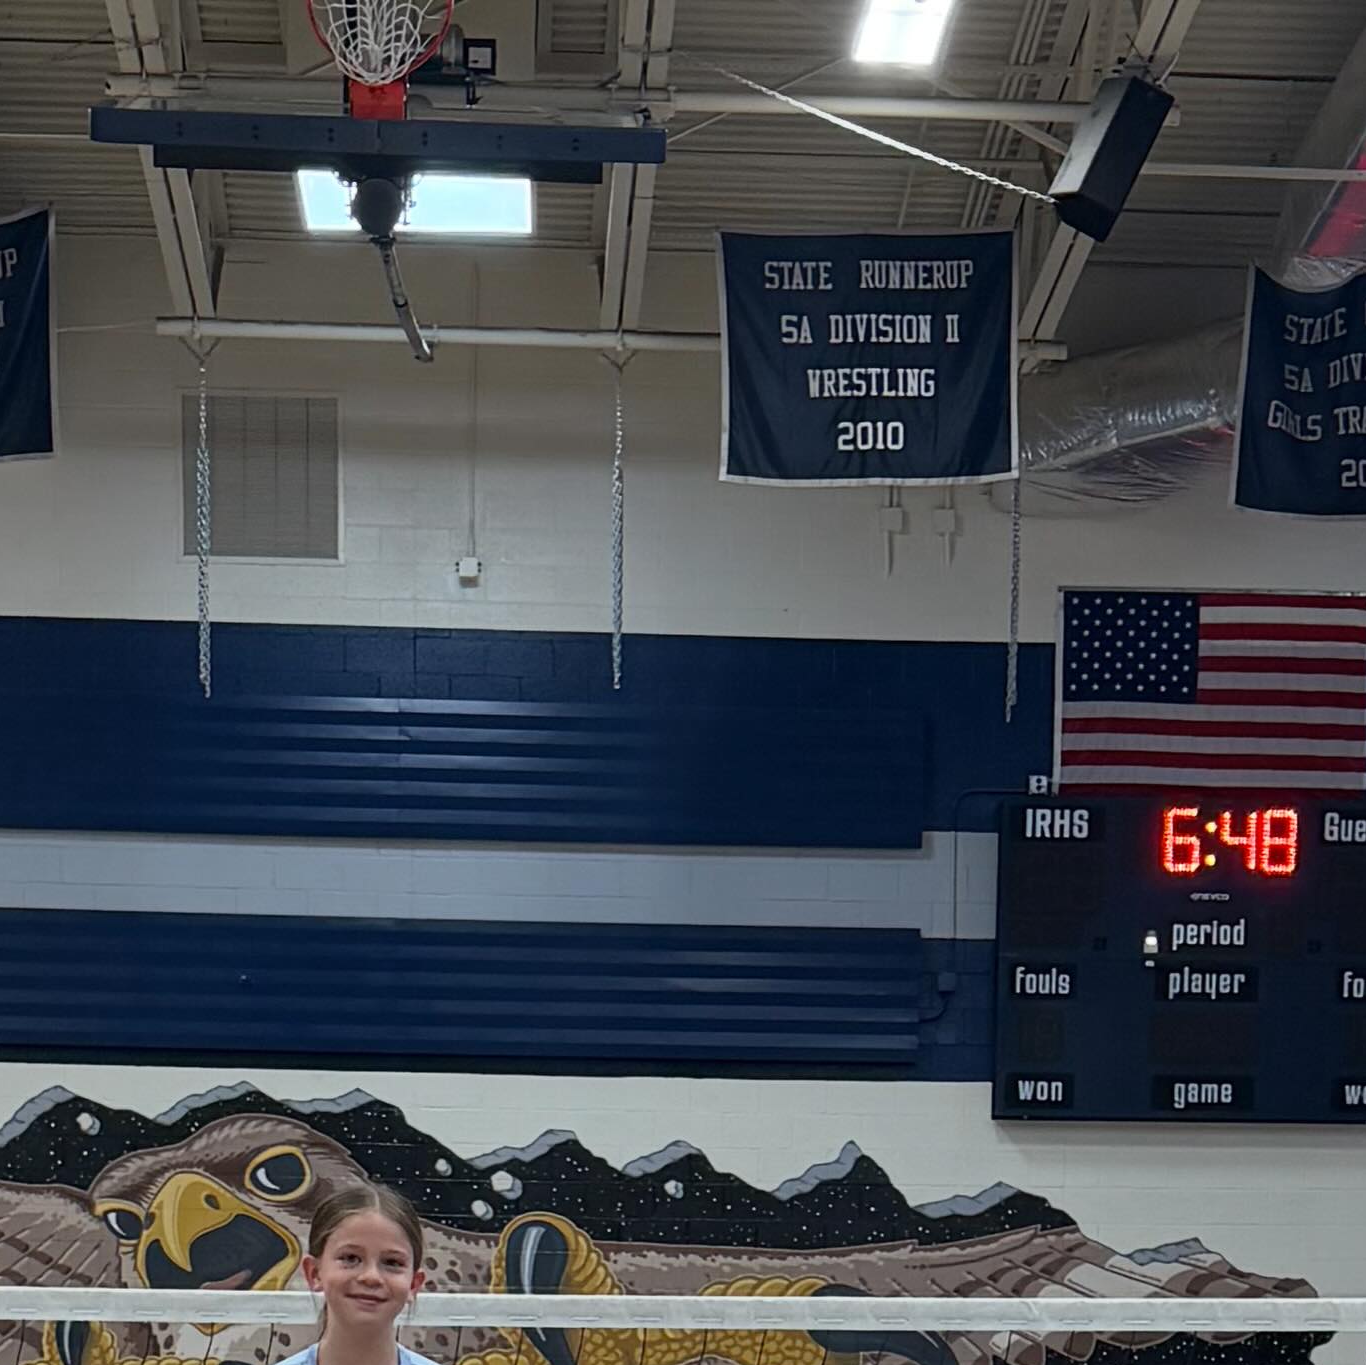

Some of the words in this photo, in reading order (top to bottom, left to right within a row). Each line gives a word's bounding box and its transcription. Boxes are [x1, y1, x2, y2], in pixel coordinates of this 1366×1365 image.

[764, 261, 833, 290] STATE
[859, 260, 973, 289] RUNNERUP
[780, 315, 813, 343] 5A
[828, 314, 932, 343] DIVISION
[945, 314, 960, 343] II
[1284, 307, 1348, 344] STATE
[807, 368, 936, 397] WRESTLING
[1284, 364, 1314, 392] 5A
[1267, 400, 1323, 441] GIRLS
[837, 421, 905, 451] 2010
[1025, 809, 1089, 839] IRHS
[1162, 807, 1298, 875] 6:48
[1172, 919, 1246, 950] period
[1016, 967, 1070, 995] fouls
[1169, 967, 1245, 999] player
[1018, 1080, 1063, 1101] won
[1173, 1081, 1233, 1109] game
